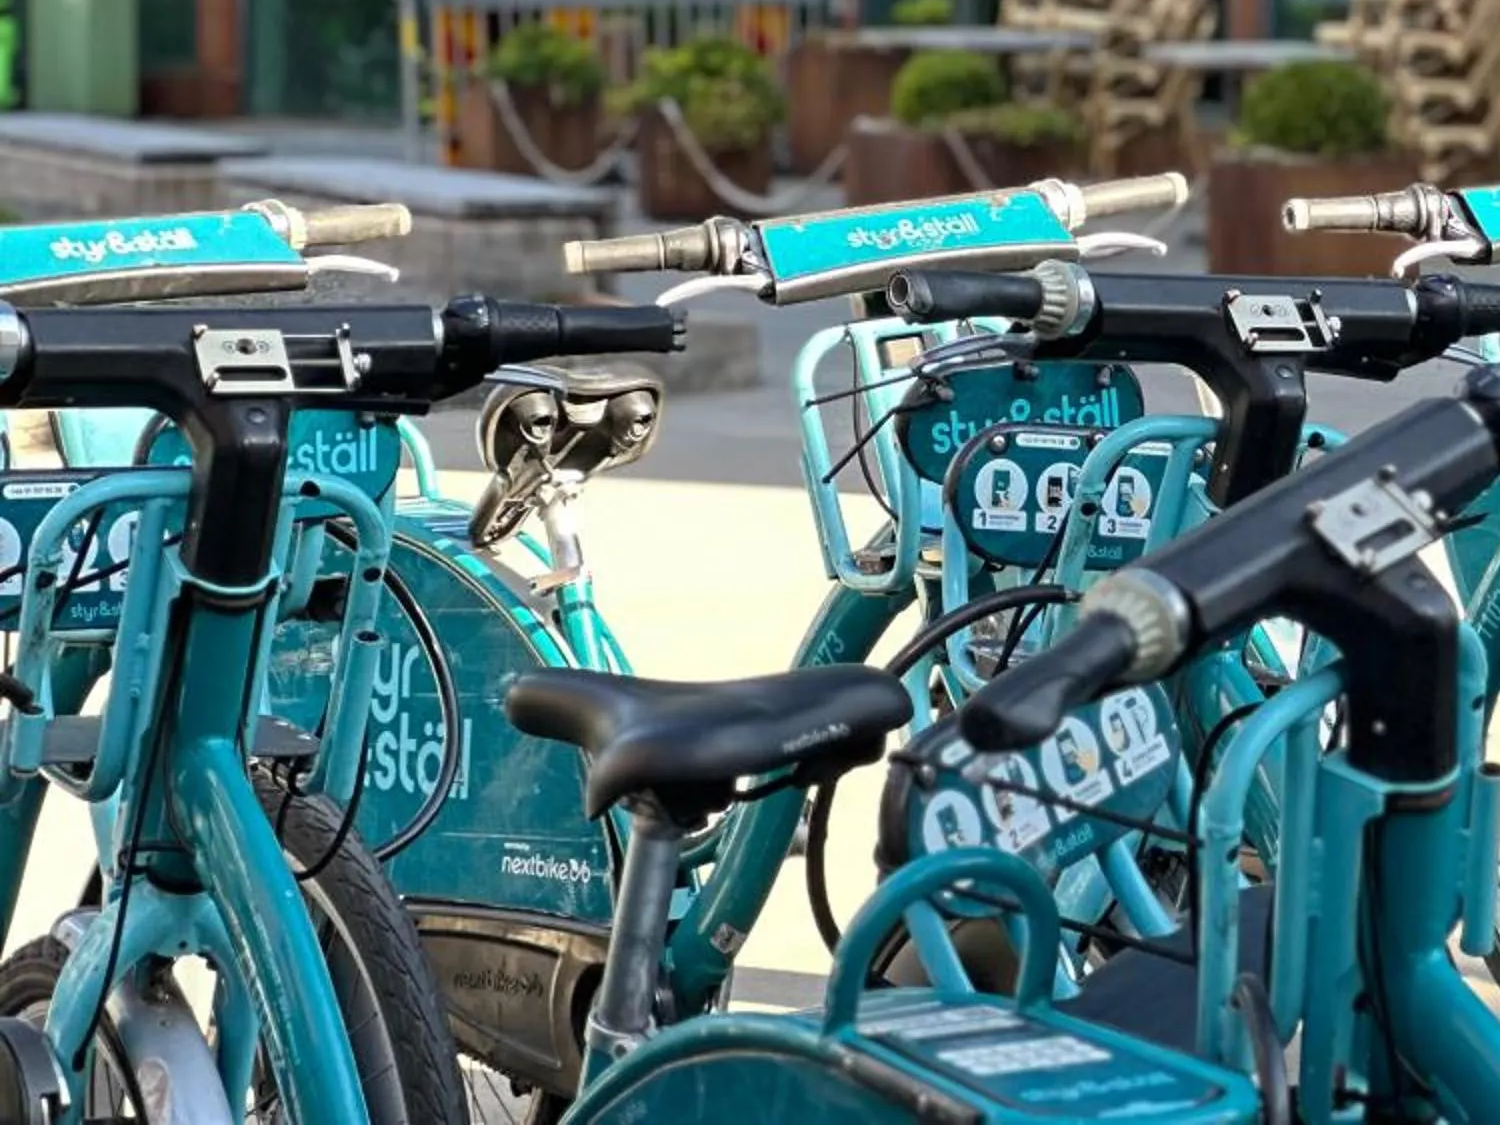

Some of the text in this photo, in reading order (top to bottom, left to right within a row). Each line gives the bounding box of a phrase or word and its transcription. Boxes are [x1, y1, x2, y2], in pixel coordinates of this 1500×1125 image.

[1046, 515, 1057, 530] 2
[1106, 518, 1117, 534] 3
[1009, 829, 1021, 848] 2
[502, 853, 569, 881] nextbike
